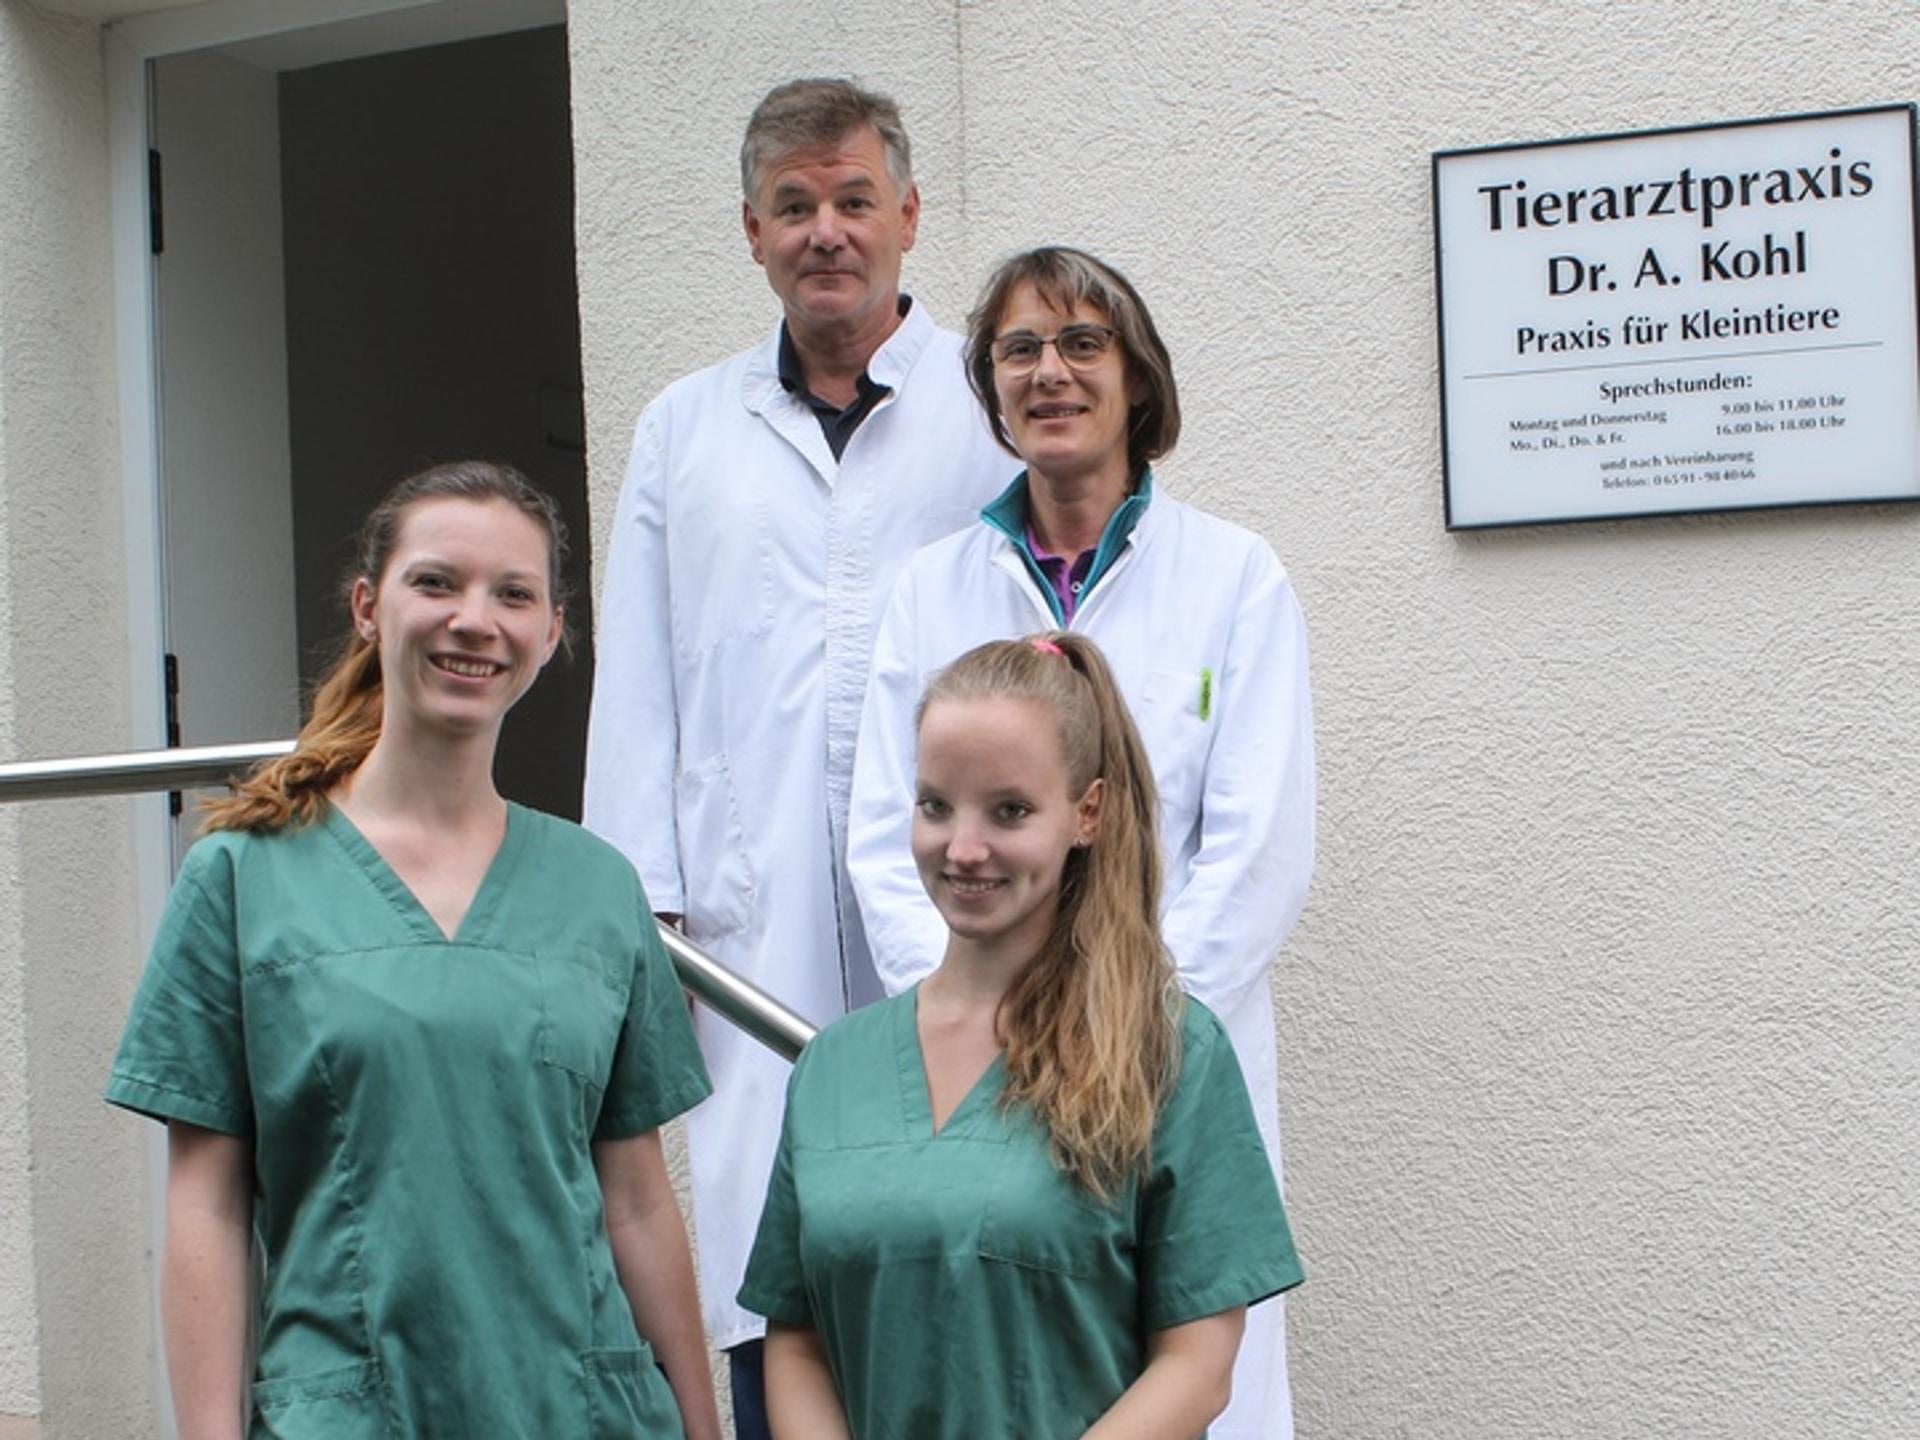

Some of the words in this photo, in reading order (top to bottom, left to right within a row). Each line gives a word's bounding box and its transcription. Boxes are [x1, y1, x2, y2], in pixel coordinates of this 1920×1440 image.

[1478, 148, 1873, 231] Tierarztpraxis
[1548, 252, 1617, 296] Dr.
[1633, 248, 1681, 289] A.
[1701, 231, 1806, 283] Kohl
[1517, 321, 1611, 355] Praxis
[1623, 316, 1669, 346] für
[1681, 304, 1841, 341] Kleintiere
[1600, 373, 1753, 403] Sprechstunden:
[1755, 400, 1774, 412] bis
[1778, 397, 1817, 411] 11.00
[1820, 394, 1847, 408] Uhr
[1509, 418, 1559, 432] Montag
[1562, 414, 1588, 428] und
[1591, 410, 1668, 425] Donnerstag
[1715, 422, 1752, 436] 16.00
[1755, 421, 1774, 433] bis
[1780, 418, 1817, 431] 18.00
[1820, 416, 1847, 429] Uhr
[1596, 434, 1607, 445] &
[1600, 457, 1627, 470] und
[1630, 455, 1662, 468] nach
